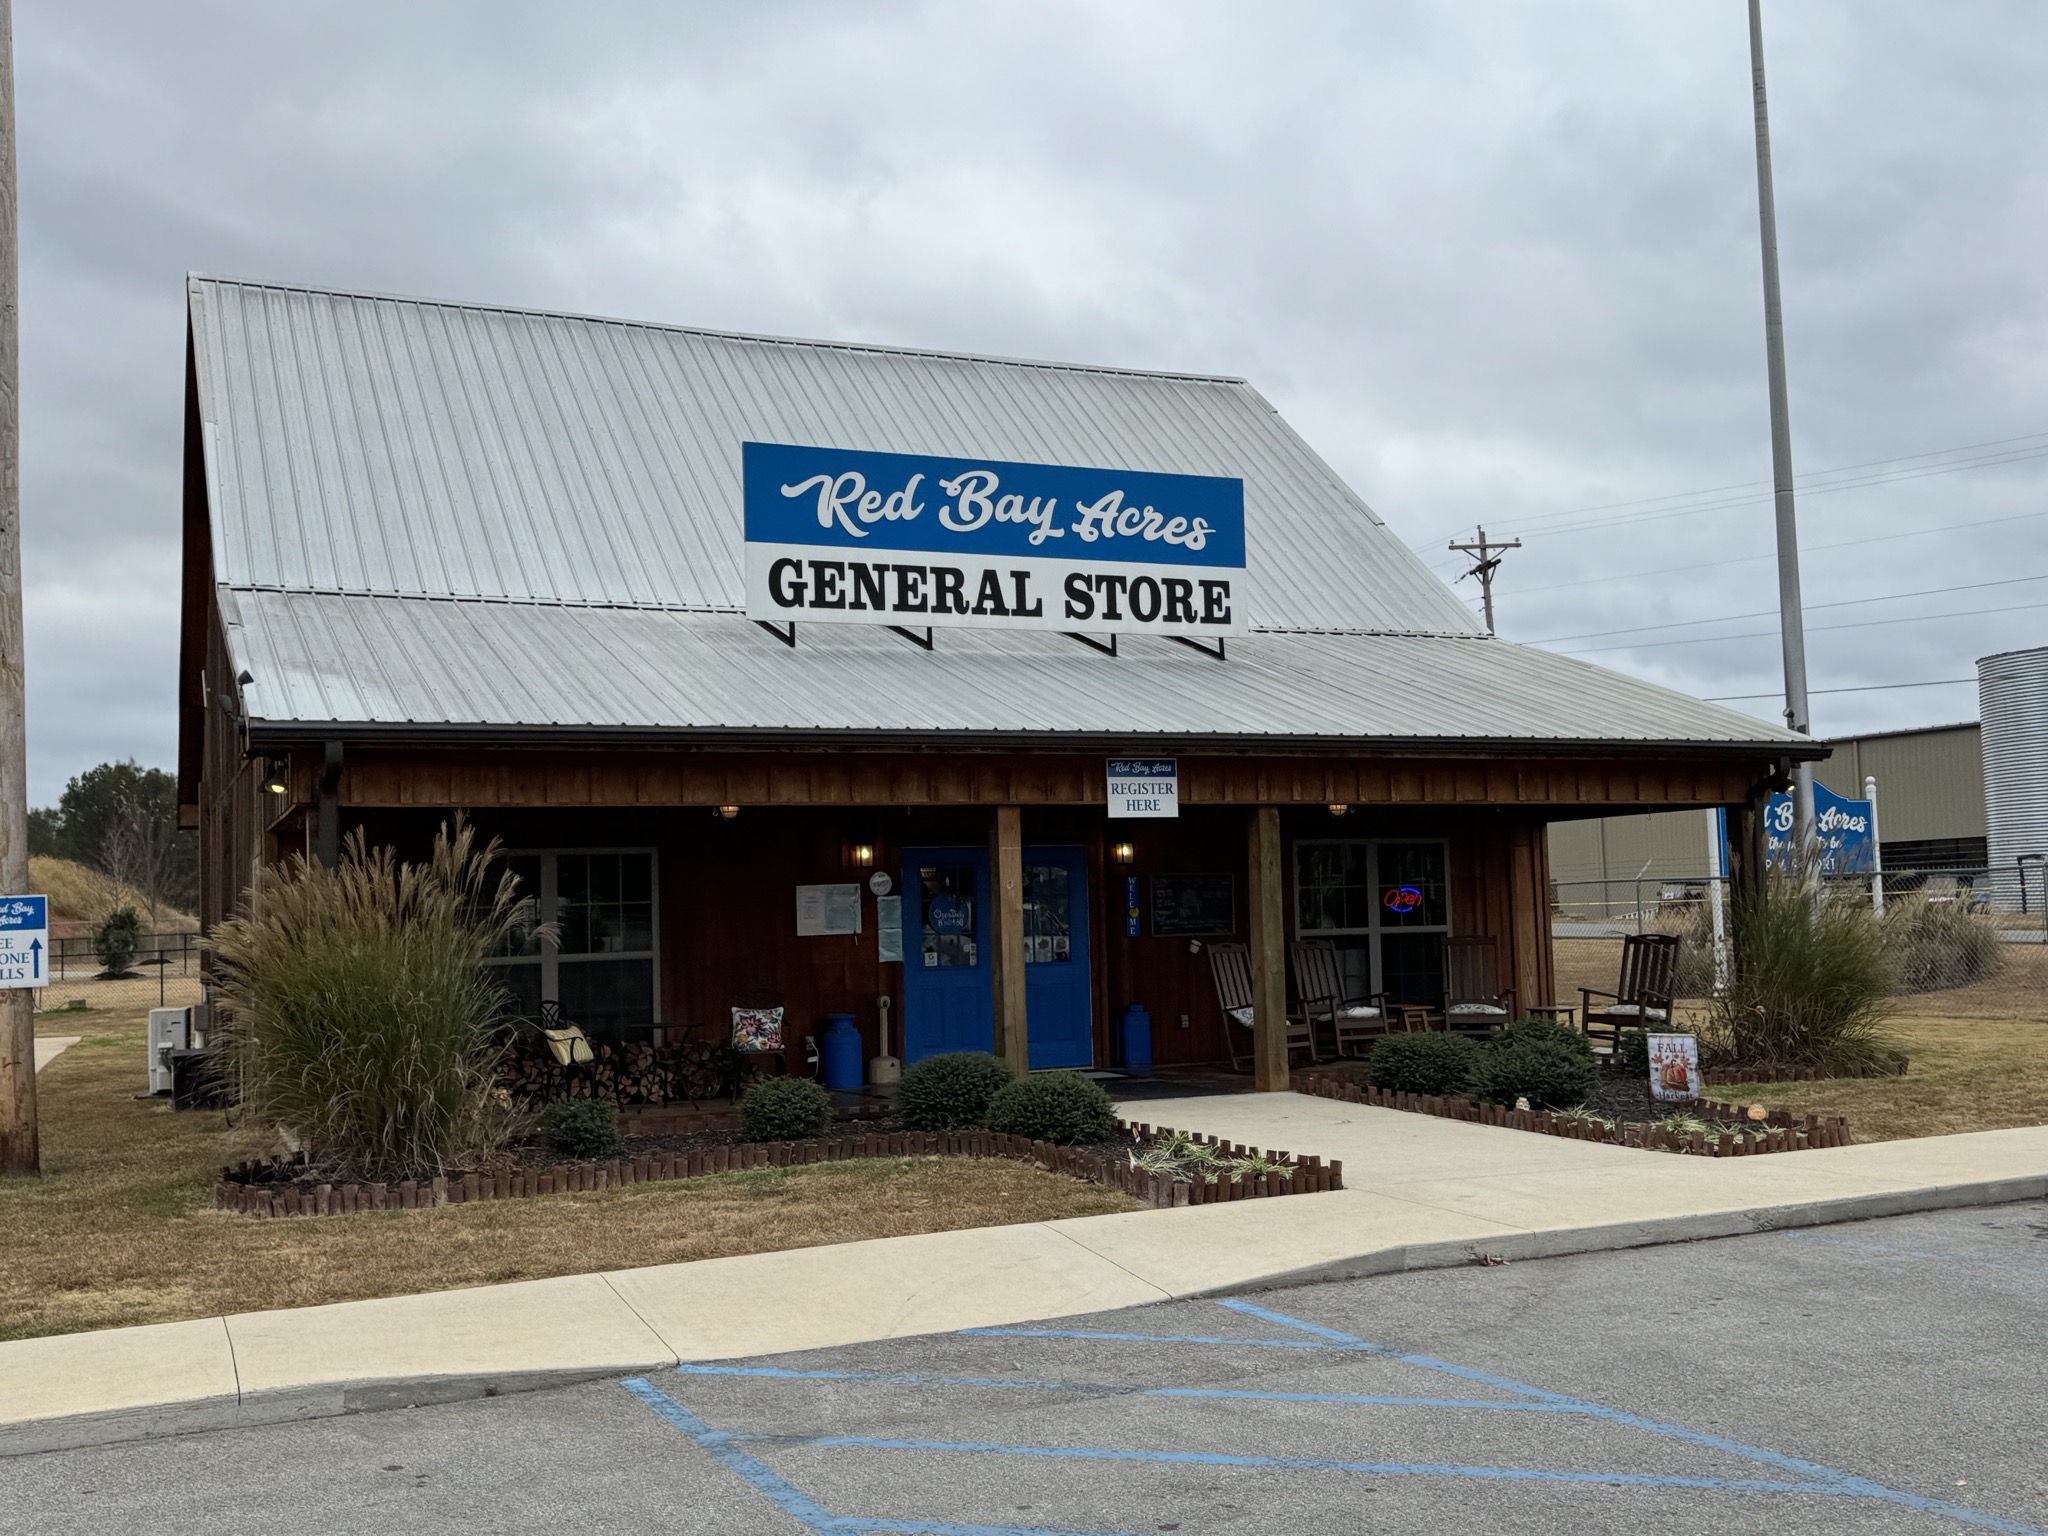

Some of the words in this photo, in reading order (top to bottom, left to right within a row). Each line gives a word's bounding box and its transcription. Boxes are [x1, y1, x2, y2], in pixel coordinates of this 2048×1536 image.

[781, 471, 925, 537] Red
[939, 470, 1064, 545] Bay
[1072, 490, 1216, 550] Acres
[768, 558, 1042, 617] GENERAL
[1064, 572, 1231, 624] STORE
[1111, 762, 1130, 772] Red
[1132, 762, 1150, 775] Bay
[1152, 763, 1171, 773] Acres
[1111, 783, 1174, 795] REGISTER
[1126, 799, 1160, 811] HERE
[1818, 806, 1868, 833] Acres
[1384, 889, 1422, 908] Open
[11, 902, 35, 916] Bay
[1657, 1043, 1688, 1053] FALL
